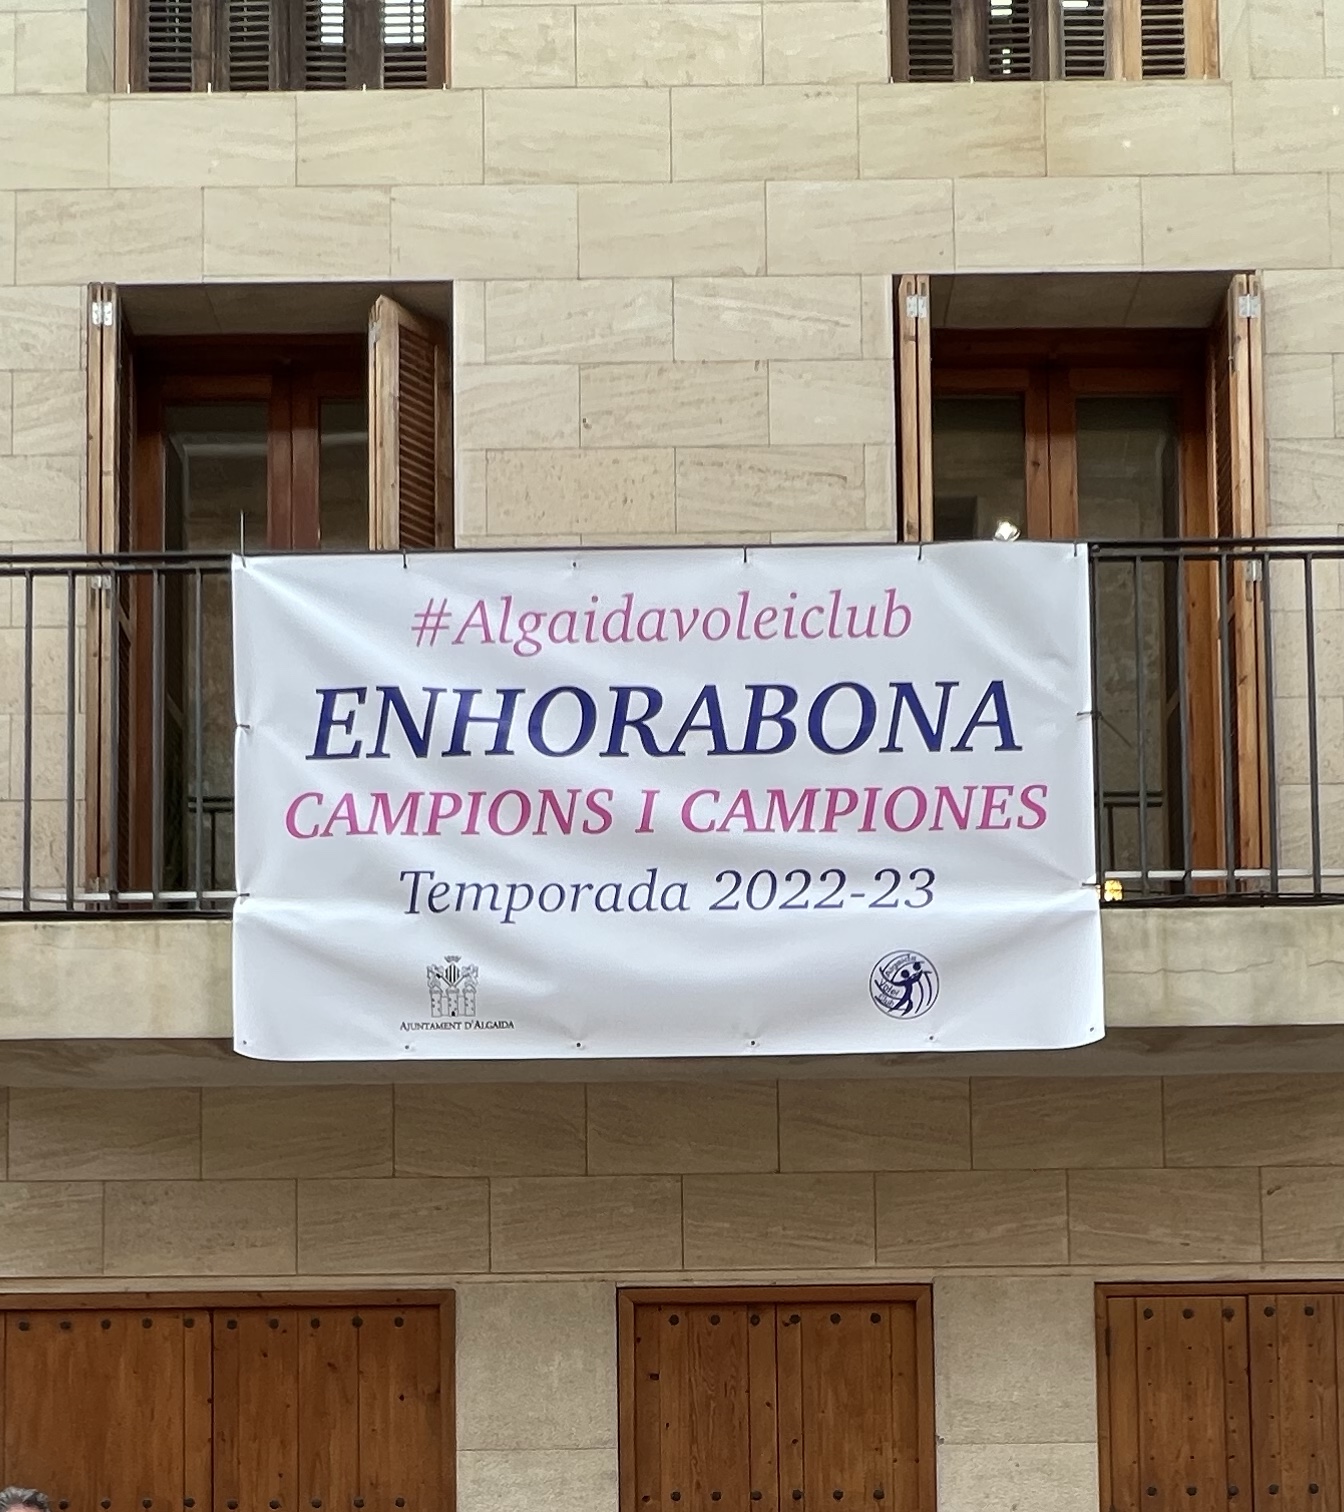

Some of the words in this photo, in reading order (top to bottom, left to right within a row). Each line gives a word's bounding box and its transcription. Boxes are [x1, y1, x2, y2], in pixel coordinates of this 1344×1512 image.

[411, 588, 912, 657] #Algaidavoleiclub
[304, 680, 1024, 761] ENHORABONA
[285, 789, 614, 840] CAMPIONS
[634, 790, 661, 834] I
[681, 785, 1048, 834] CAMPIONES
[400, 868, 690, 925] Temporada
[708, 867, 937, 912] 2022-23
